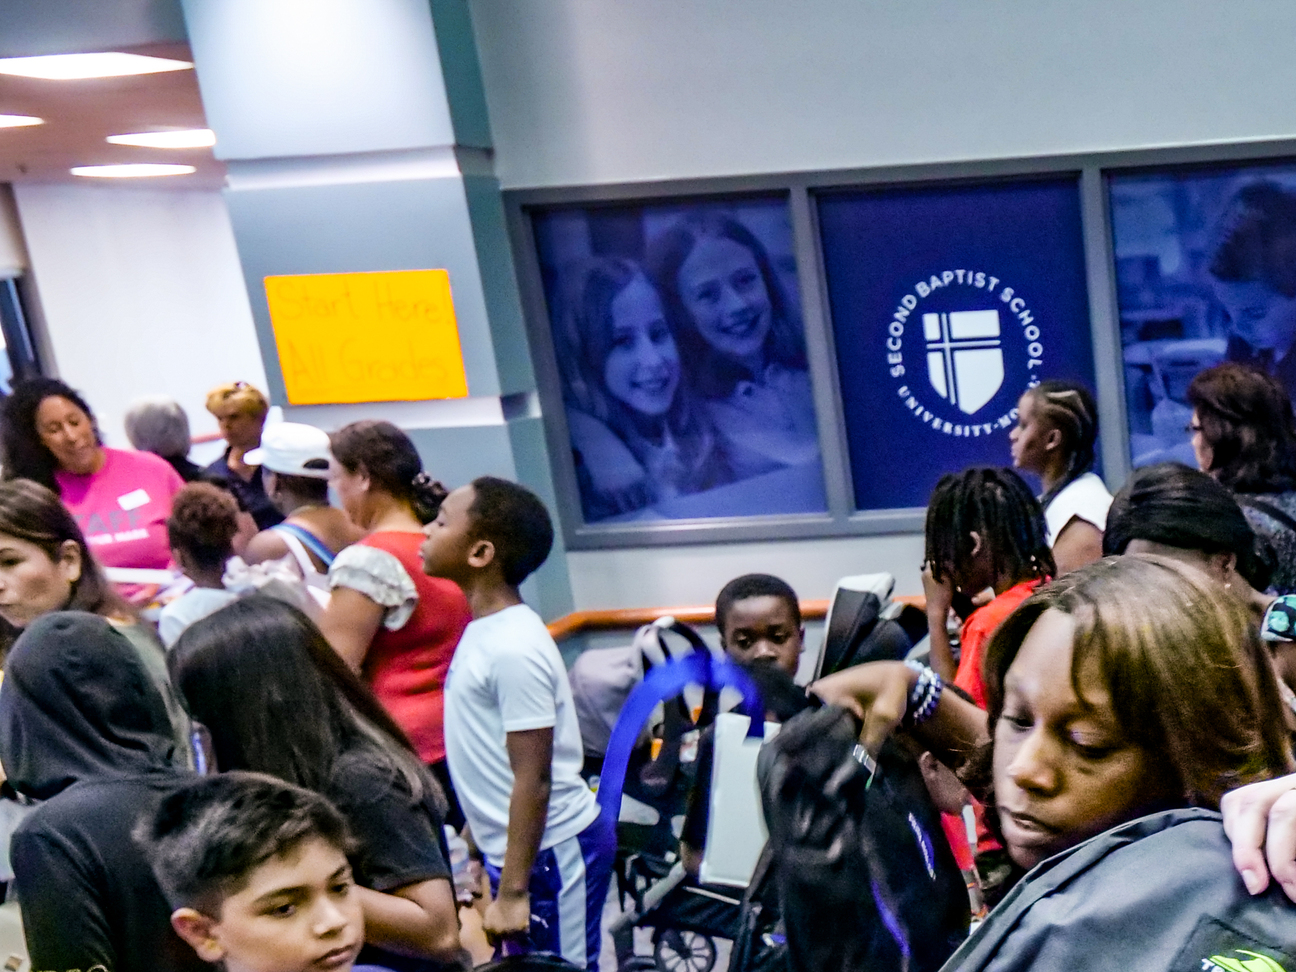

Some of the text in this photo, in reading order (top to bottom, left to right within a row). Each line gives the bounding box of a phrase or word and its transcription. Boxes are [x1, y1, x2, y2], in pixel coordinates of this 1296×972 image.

[276, 278, 359, 321] Start
[886, 269, 1044, 378] SECOND BAPTIST SCHOOL
[286, 336, 448, 386] All Grades
